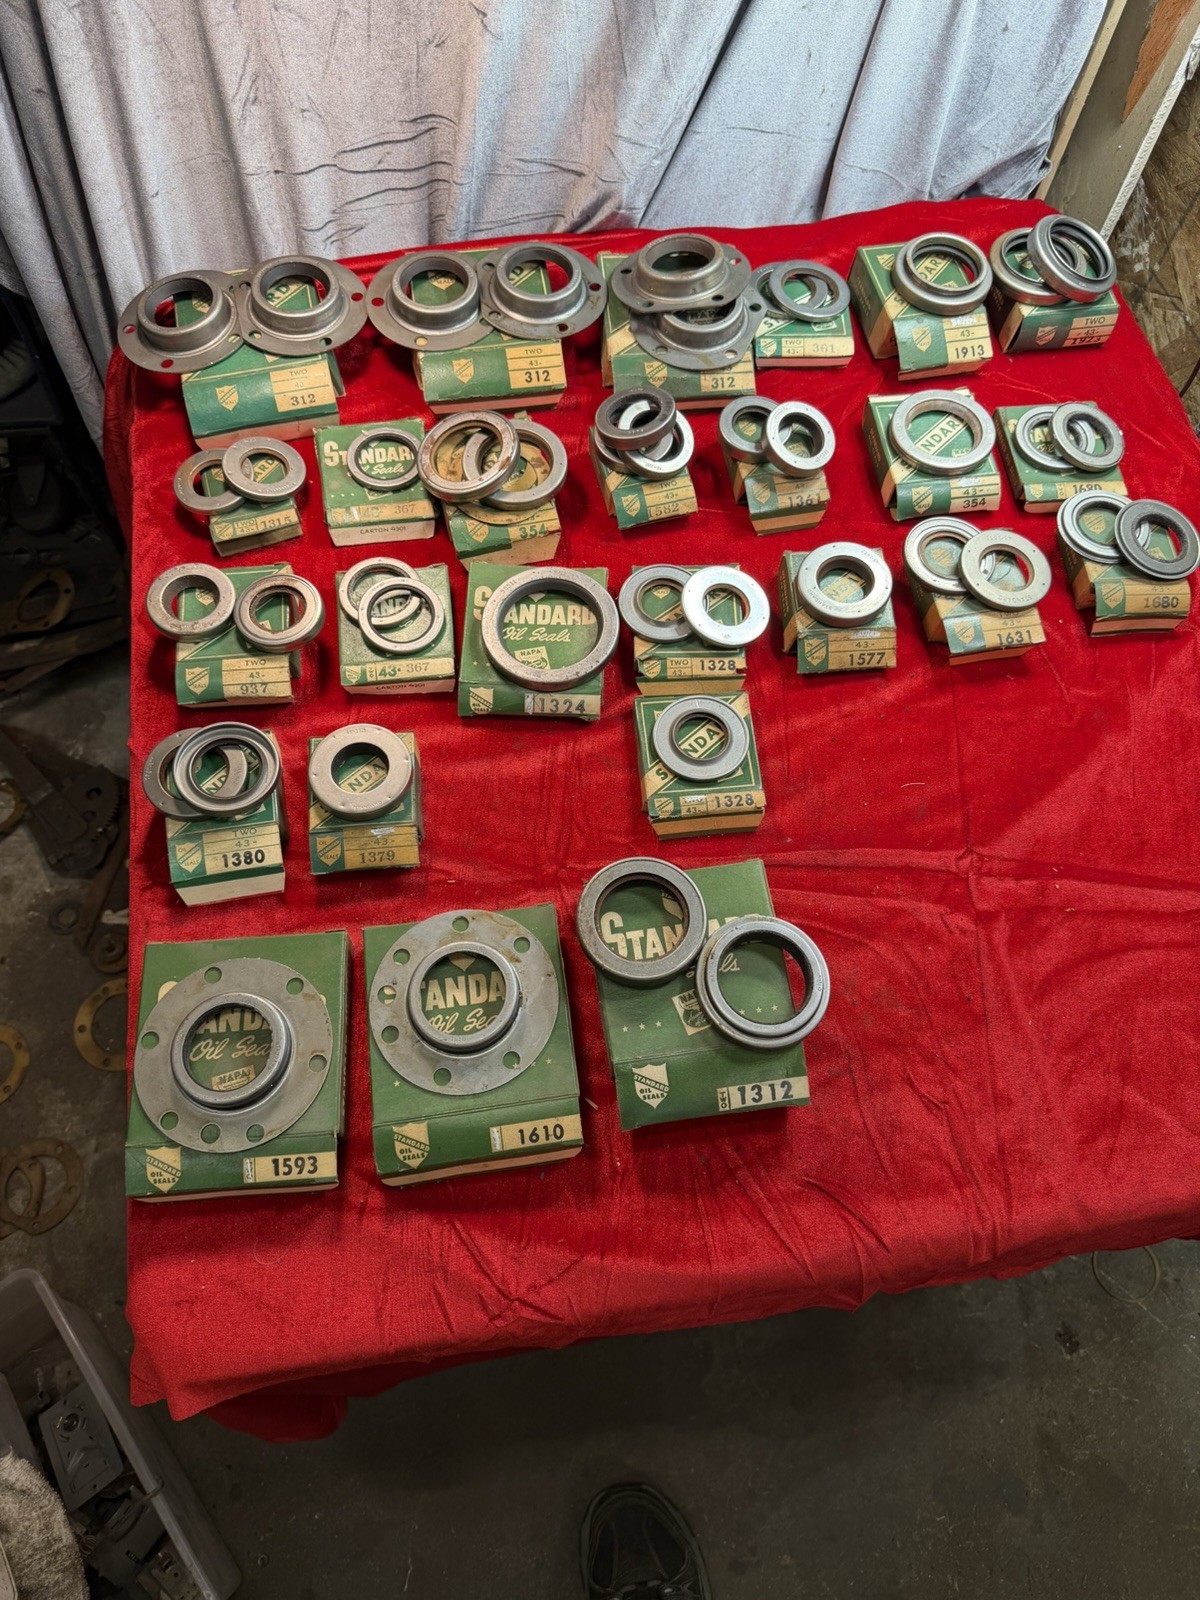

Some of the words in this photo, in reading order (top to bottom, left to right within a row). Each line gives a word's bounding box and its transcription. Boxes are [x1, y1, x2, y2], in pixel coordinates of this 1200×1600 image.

[1084, 316, 1106, 325] TWO
[812, 344, 836, 354] 361
[955, 345, 985, 358] 1913
[290, 368, 308, 376] TWO
[525, 370, 550, 383] 312
[711, 377, 736, 388] 312
[291, 394, 316, 406] 312
[788, 494, 820, 508] 1361
[962, 498, 986, 509] 354
[394, 504, 416, 514] 367
[648, 504, 680, 518] 1582
[262, 516, 292, 529] 1315
[518, 524, 548, 538] 354
[474, 585, 597, 625] SANDARD
[1144, 596, 1178, 608] 1680
[502, 626, 527, 640] Oil
[528, 627, 570, 642] Seals
[997, 630, 1032, 645] 1631
[700, 660, 736, 670] 1328
[849, 652, 886, 666] 1577
[406, 662, 430, 672] 367
[240, 684, 268, 694] 937
[540, 698, 586, 714] 1324
[714, 794, 754, 808] 1328
[232, 828, 257, 836] TWO
[235, 840, 257, 848] 43-
[222, 850, 264, 868] 1380
[360, 850, 396, 864] 1379
[463, 1008, 497, 1032] Sea
[190, 1038, 230, 1062] Oil
[231, 1034, 270, 1058] Sea
[217, 1069, 250, 1085] NAPA
[634, 1074, 670, 1092] STANDARD
[642, 1092, 666, 1100] SEALS
[720, 1090, 728, 1110] TWO
[738, 1081, 793, 1106] 1312
[518, 1124, 564, 1145] 1610
[394, 1134, 430, 1152] STANDARD
[402, 1152, 426, 1161] SEALS
[146, 1156, 182, 1177] STANDARD
[272, 1155, 318, 1176] 1593
